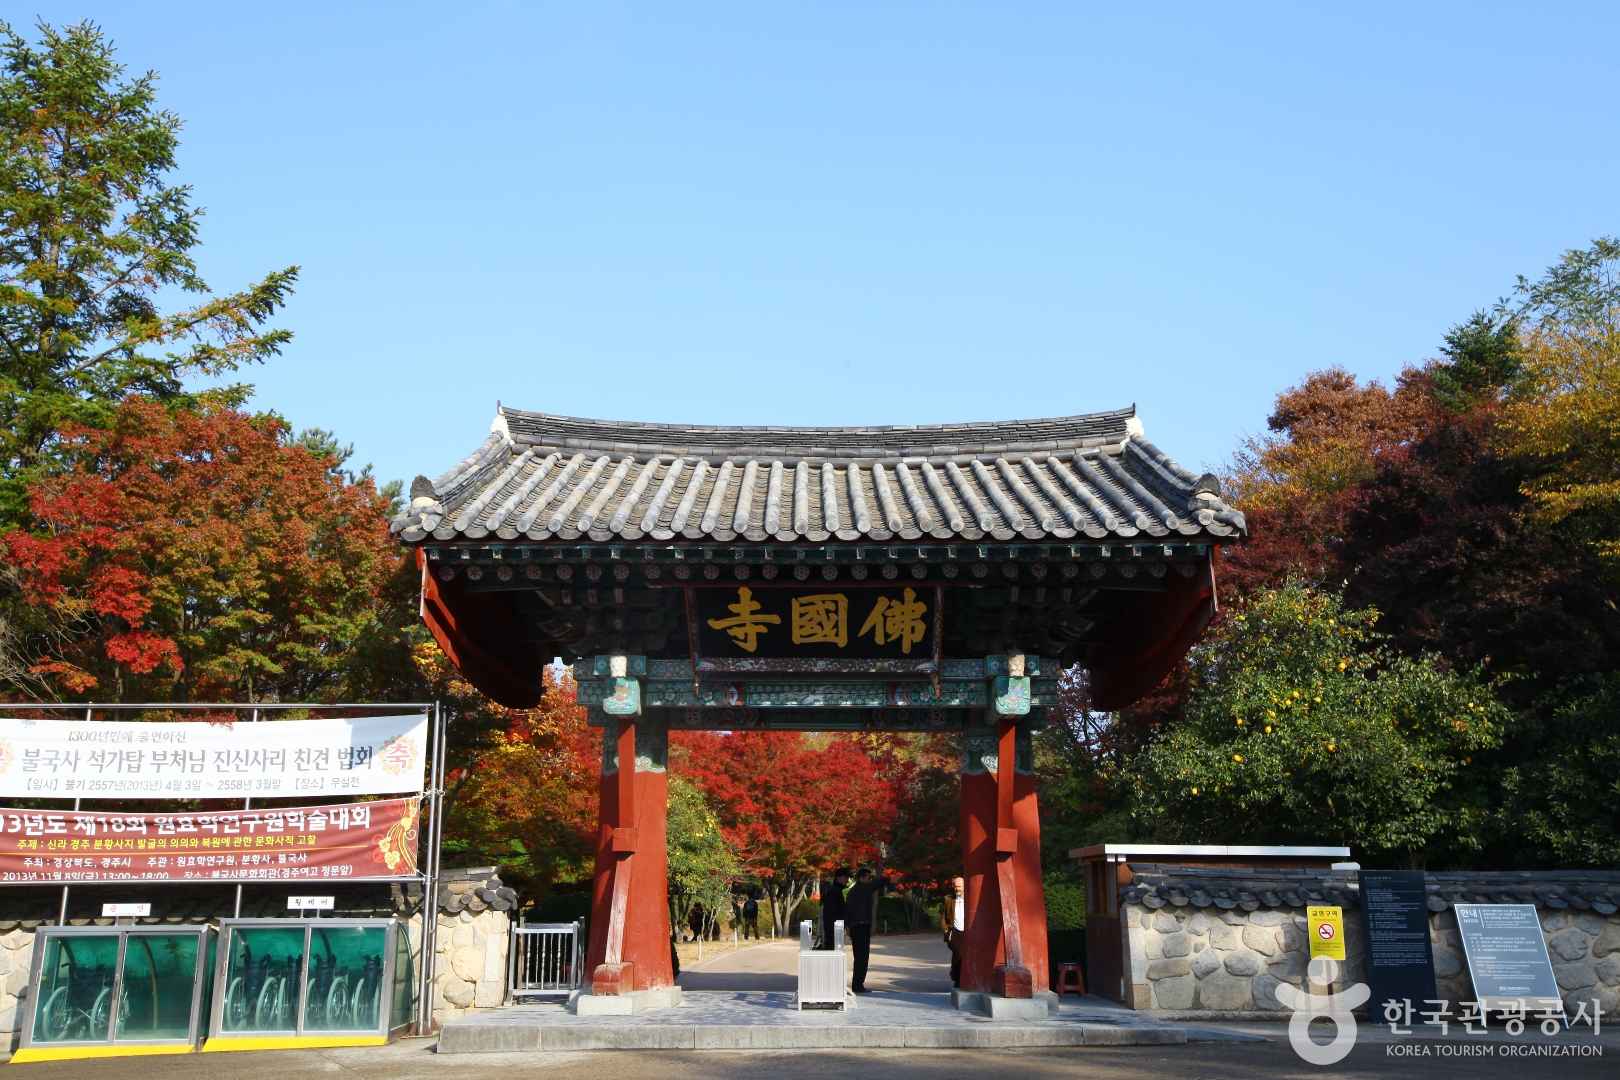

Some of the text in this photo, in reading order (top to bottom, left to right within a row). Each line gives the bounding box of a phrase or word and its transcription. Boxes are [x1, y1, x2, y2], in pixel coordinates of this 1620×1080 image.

[22, 748, 80, 773] 불국사
[88, 748, 144, 773] 석가탑
[150, 748, 206, 773] 부처님
[213, 748, 286, 773] 진신사리
[294, 747, 330, 771] 친견
[337, 745, 373, 770] 법회
[386, 742, 407, 769] 축
[73, 816, 147, 835] 제18회
[48, 839, 66, 849] 신라
